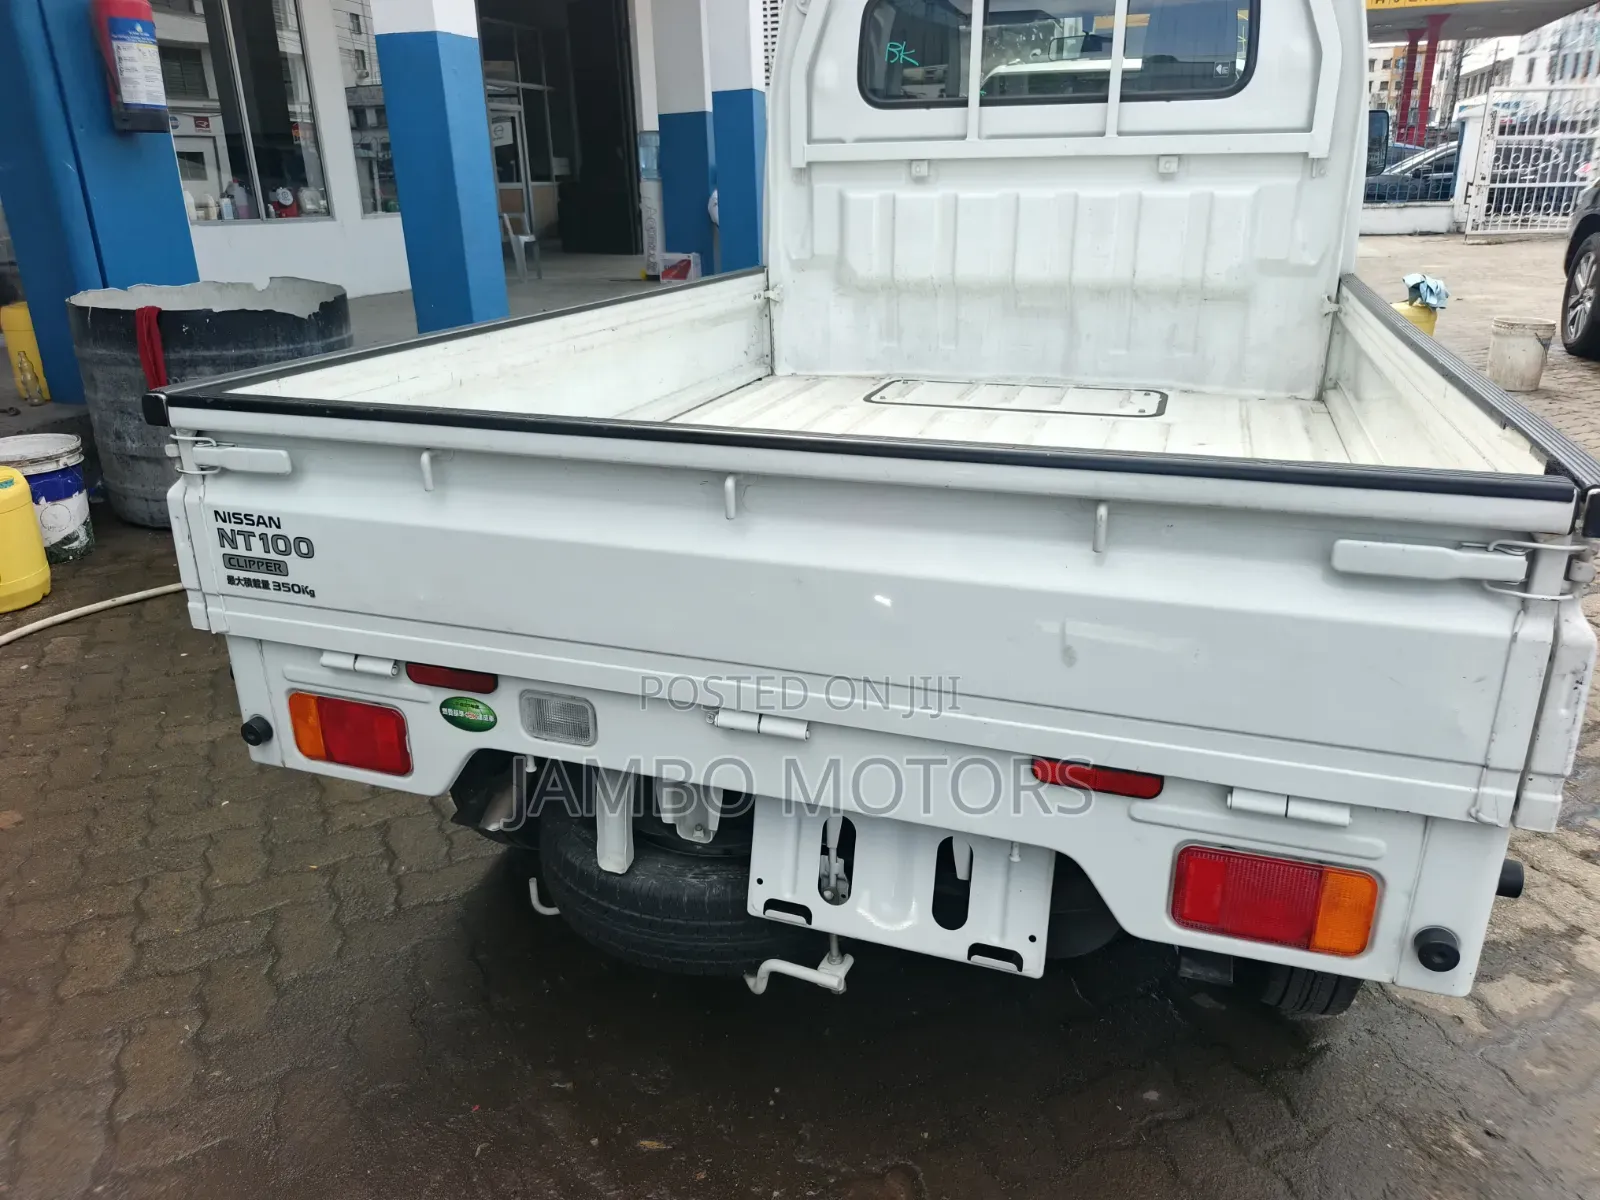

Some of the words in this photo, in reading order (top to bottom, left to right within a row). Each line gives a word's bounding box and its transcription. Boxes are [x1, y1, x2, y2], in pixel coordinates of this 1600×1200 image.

[884, 41, 919, 66] BK
[213, 509, 282, 530] NISSAN
[216, 527, 315, 559] NT100
[227, 556, 283, 573] CLIPPER
